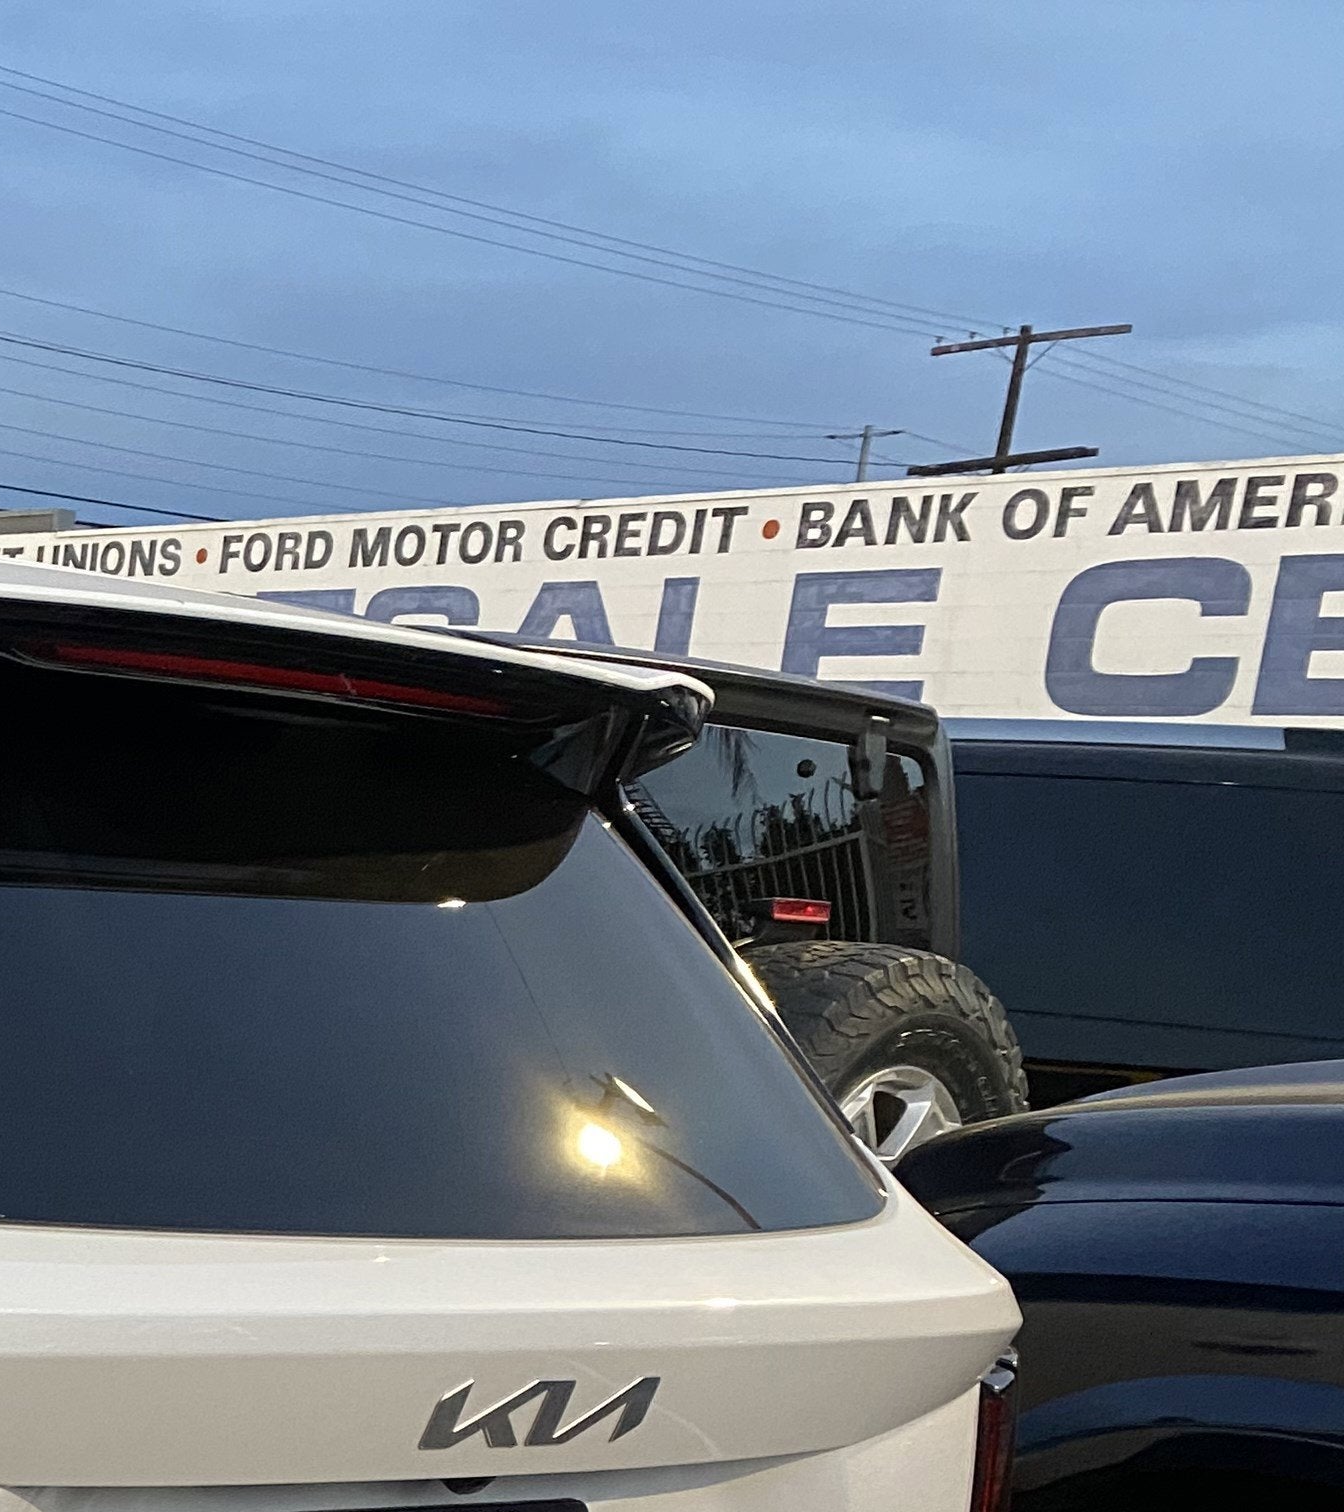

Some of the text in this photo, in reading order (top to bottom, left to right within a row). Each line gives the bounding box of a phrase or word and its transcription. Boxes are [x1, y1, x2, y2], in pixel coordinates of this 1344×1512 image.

[218, 530, 334, 574] FORD
[348, 519, 526, 568] MOTOR
[543, 506, 749, 562] CREDIT
[795, 492, 979, 549] BANK
[1002, 485, 1095, 540] OF
[1107, 472, 1344, 536] AMER
